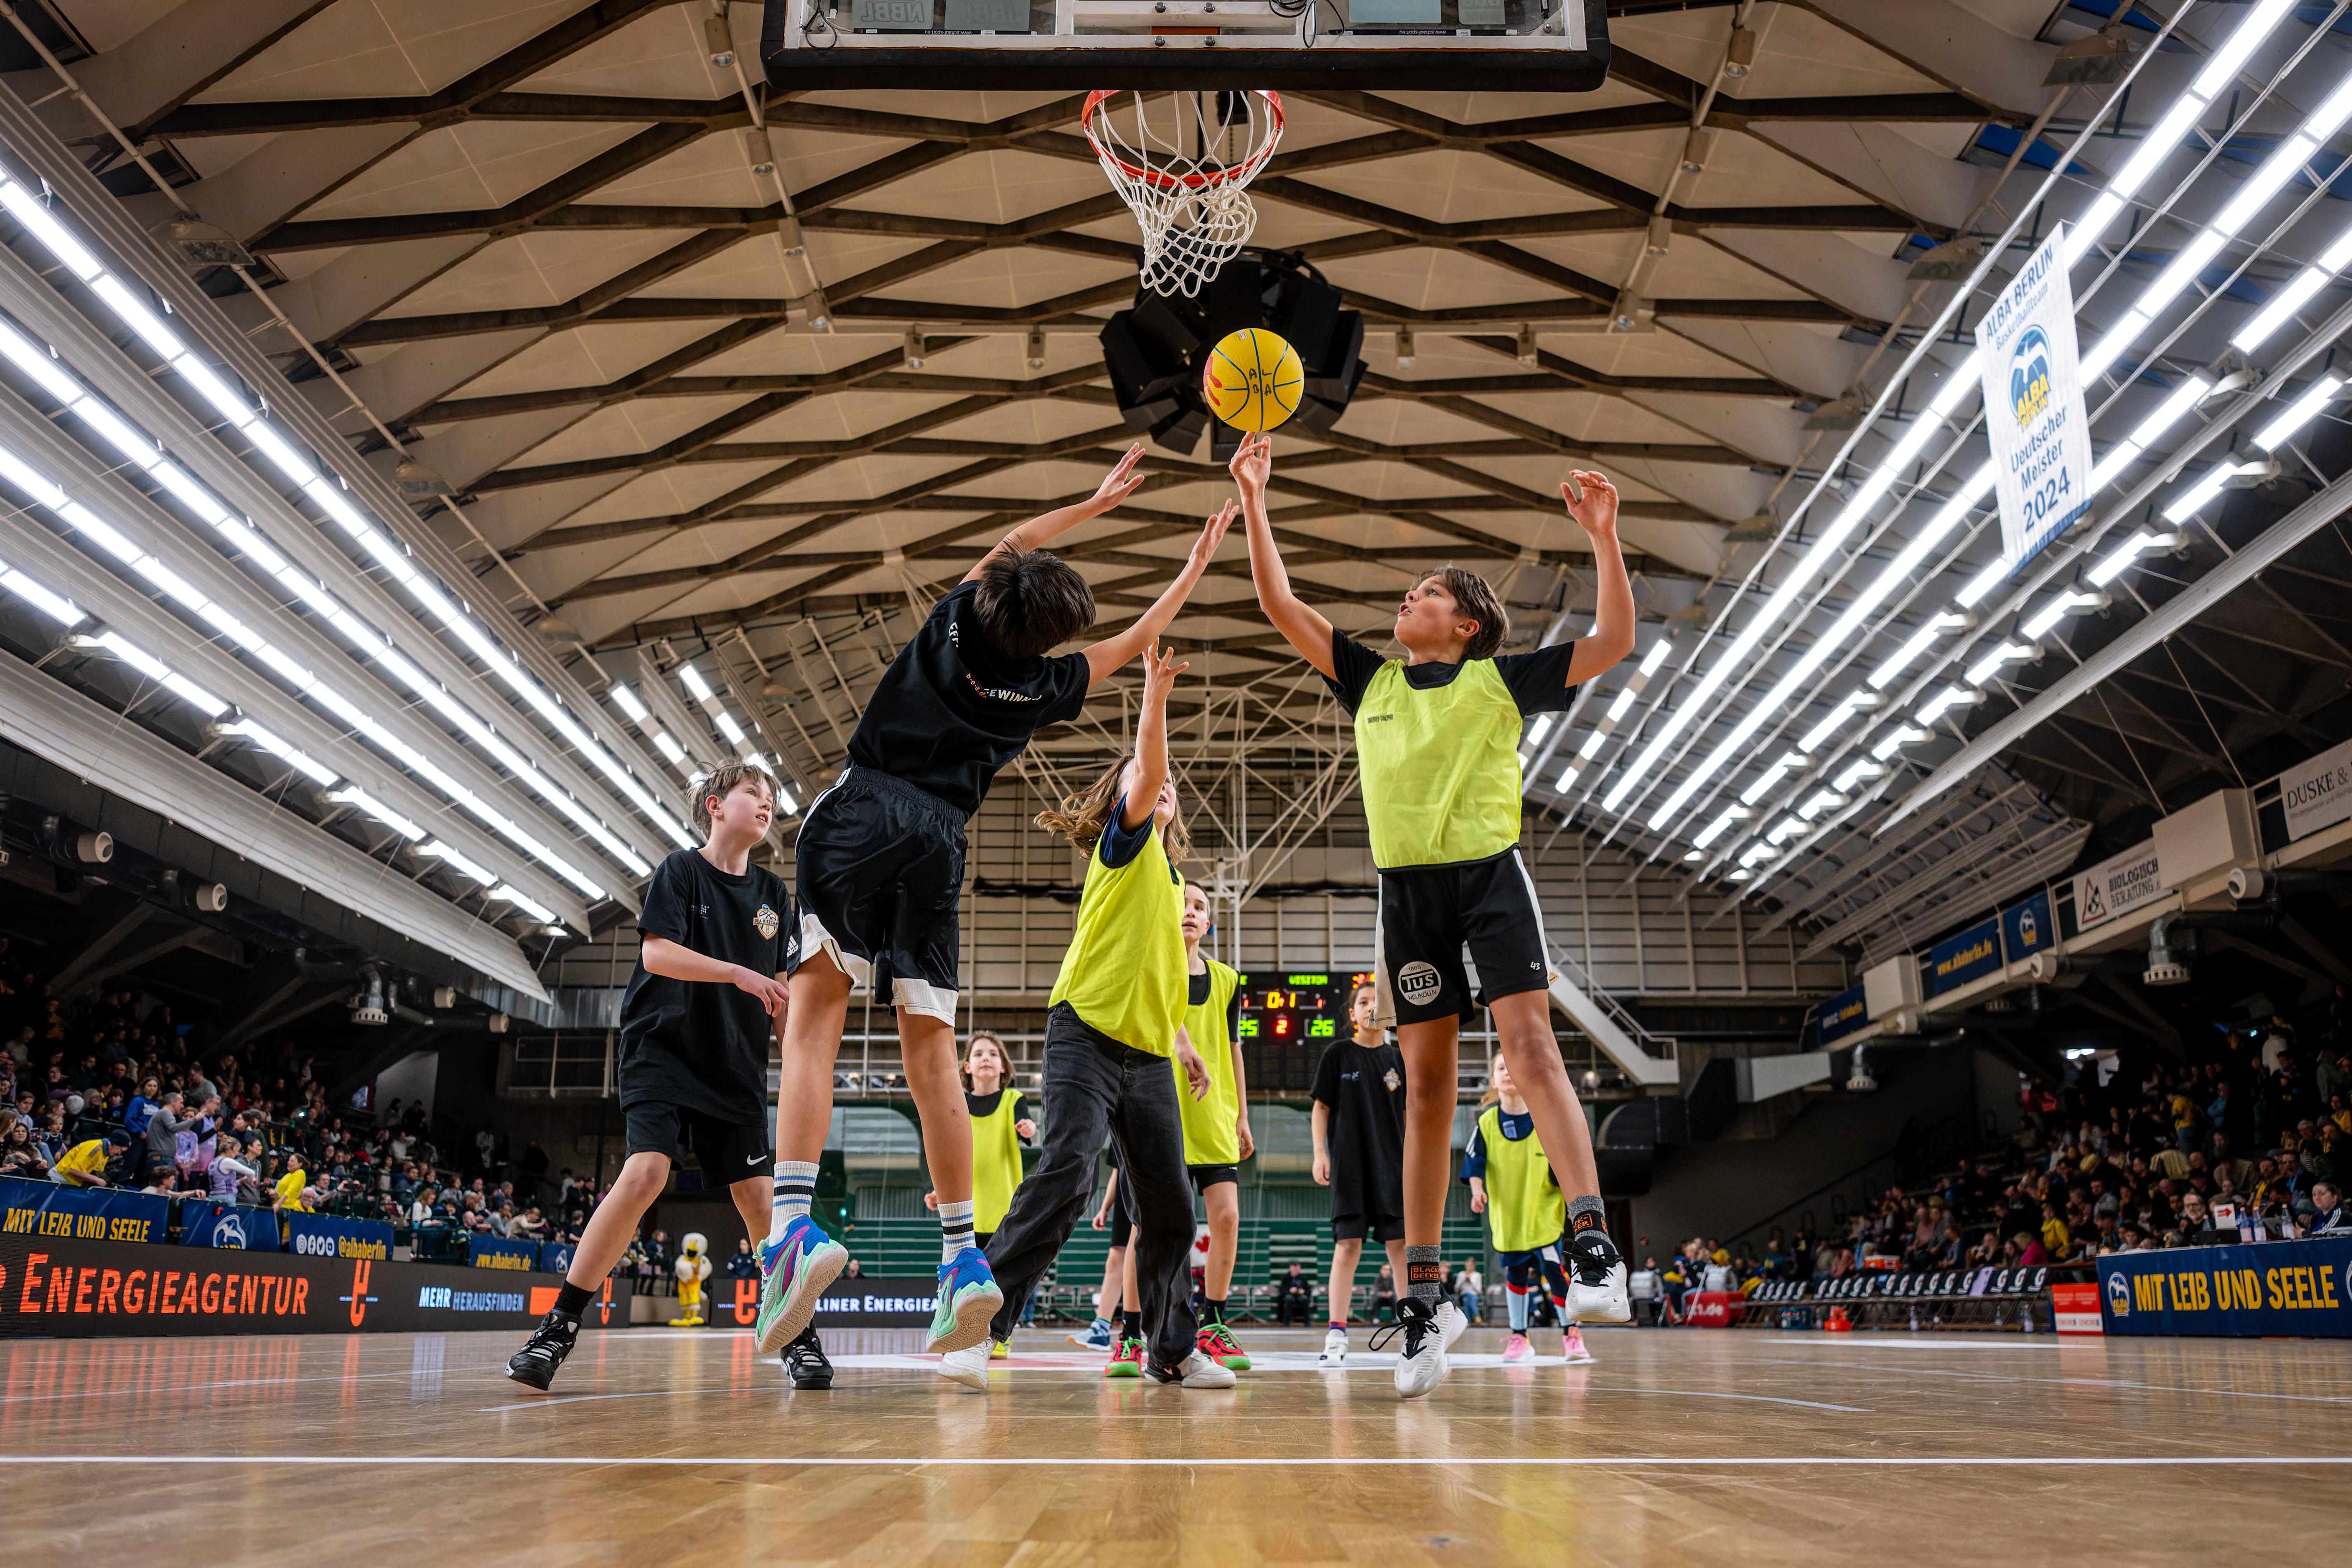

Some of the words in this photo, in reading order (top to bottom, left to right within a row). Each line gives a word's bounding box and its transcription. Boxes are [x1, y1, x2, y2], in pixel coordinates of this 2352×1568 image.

[1986, 297, 2012, 343] ALBA
[2015, 244, 2053, 306] BERLIN
[1996, 282, 2048, 351] Basketballteam
[2018, 373, 2050, 425] ALBA
[2021, 439, 2062, 492] Meister
[2023, 466, 2071, 533] 2024
[2288, 771, 2334, 809] DUSKE
[2338, 767, 2347, 785] &
[1402, 970, 1434, 991] TUS
[1408, 989, 1437, 1000] NEUKÖLLN
[1276, 1019, 1288, 1034] 2
[1311, 1019, 1334, 1036] 26
[2, 1208, 35, 1234] MIT
[39, 1211, 73, 1236] LEIB
[77, 1215, 105, 1239] UND
[109, 1217, 150, 1242] SEELE
[339, 1235, 386, 1260] @albaberlin
[19, 1253, 309, 1316] ENERGIEAGENTUR
[418, 1286, 451, 1307] MEHR
[452, 1292, 524, 1311] HERAUSFINDEN
[2134, 1274, 2164, 1311] MIT
[2170, 1271, 2211, 1311] LEIB
[2214, 1269, 2262, 1310] UND
[2266, 1265, 2339, 1309] SEELE
